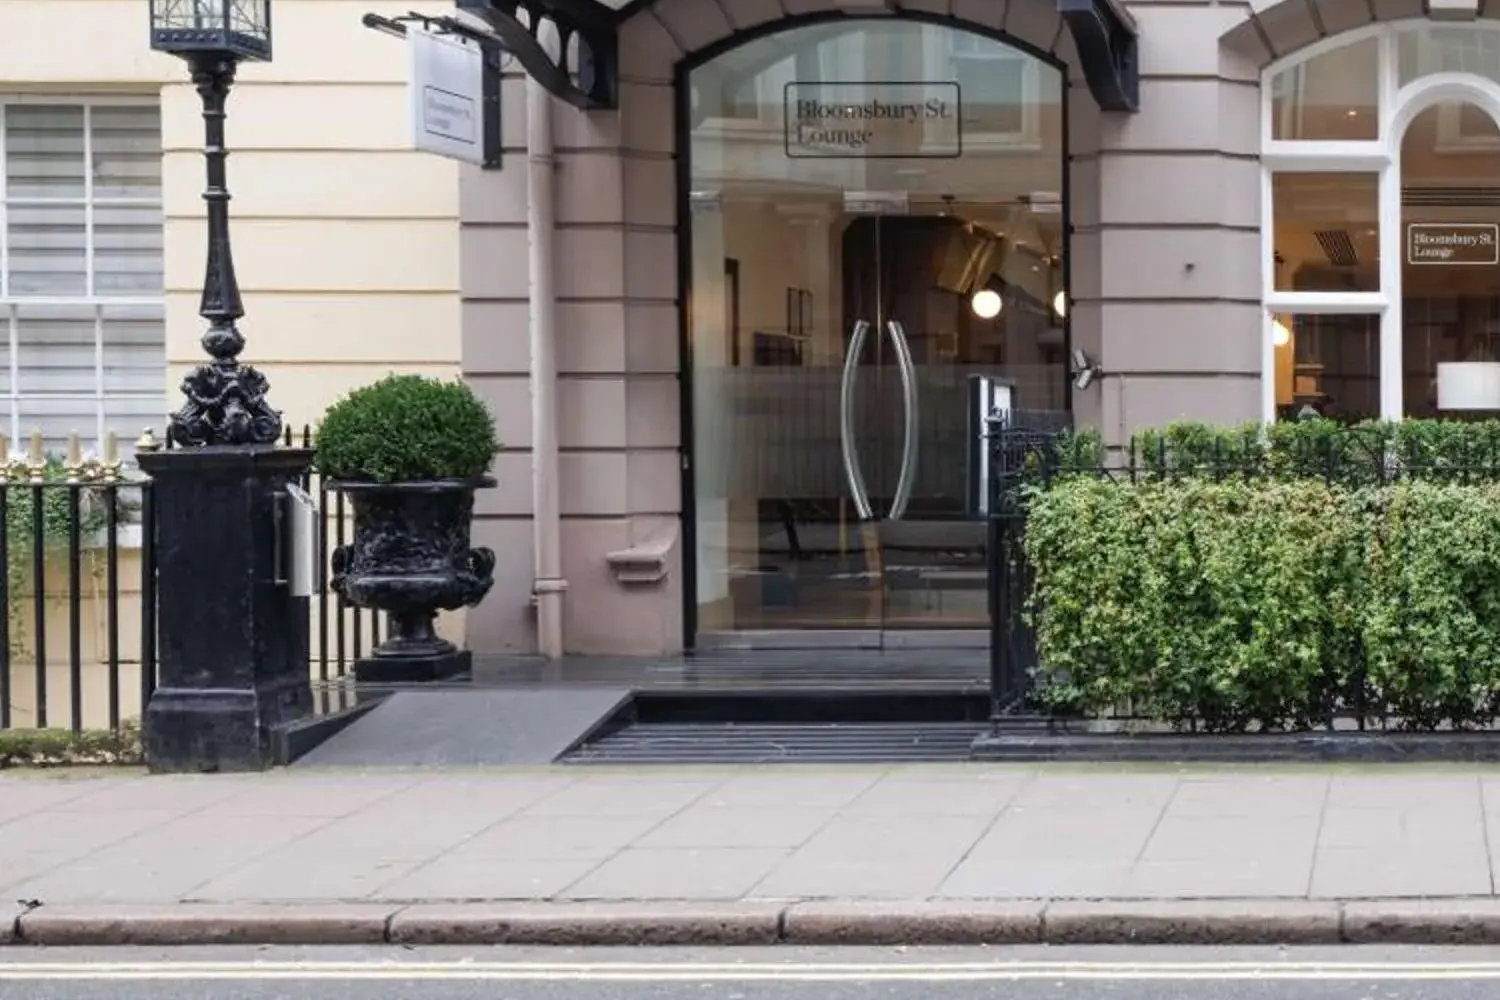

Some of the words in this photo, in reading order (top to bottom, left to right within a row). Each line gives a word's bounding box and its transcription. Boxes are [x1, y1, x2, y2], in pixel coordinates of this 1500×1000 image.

[796, 98, 918, 124] Bloomsbury
[925, 98, 952, 119] St.
[796, 124, 873, 148] Lounge
[1414, 232, 1478, 246] Bloomsbury
[1414, 246, 1454, 259] Lounge
